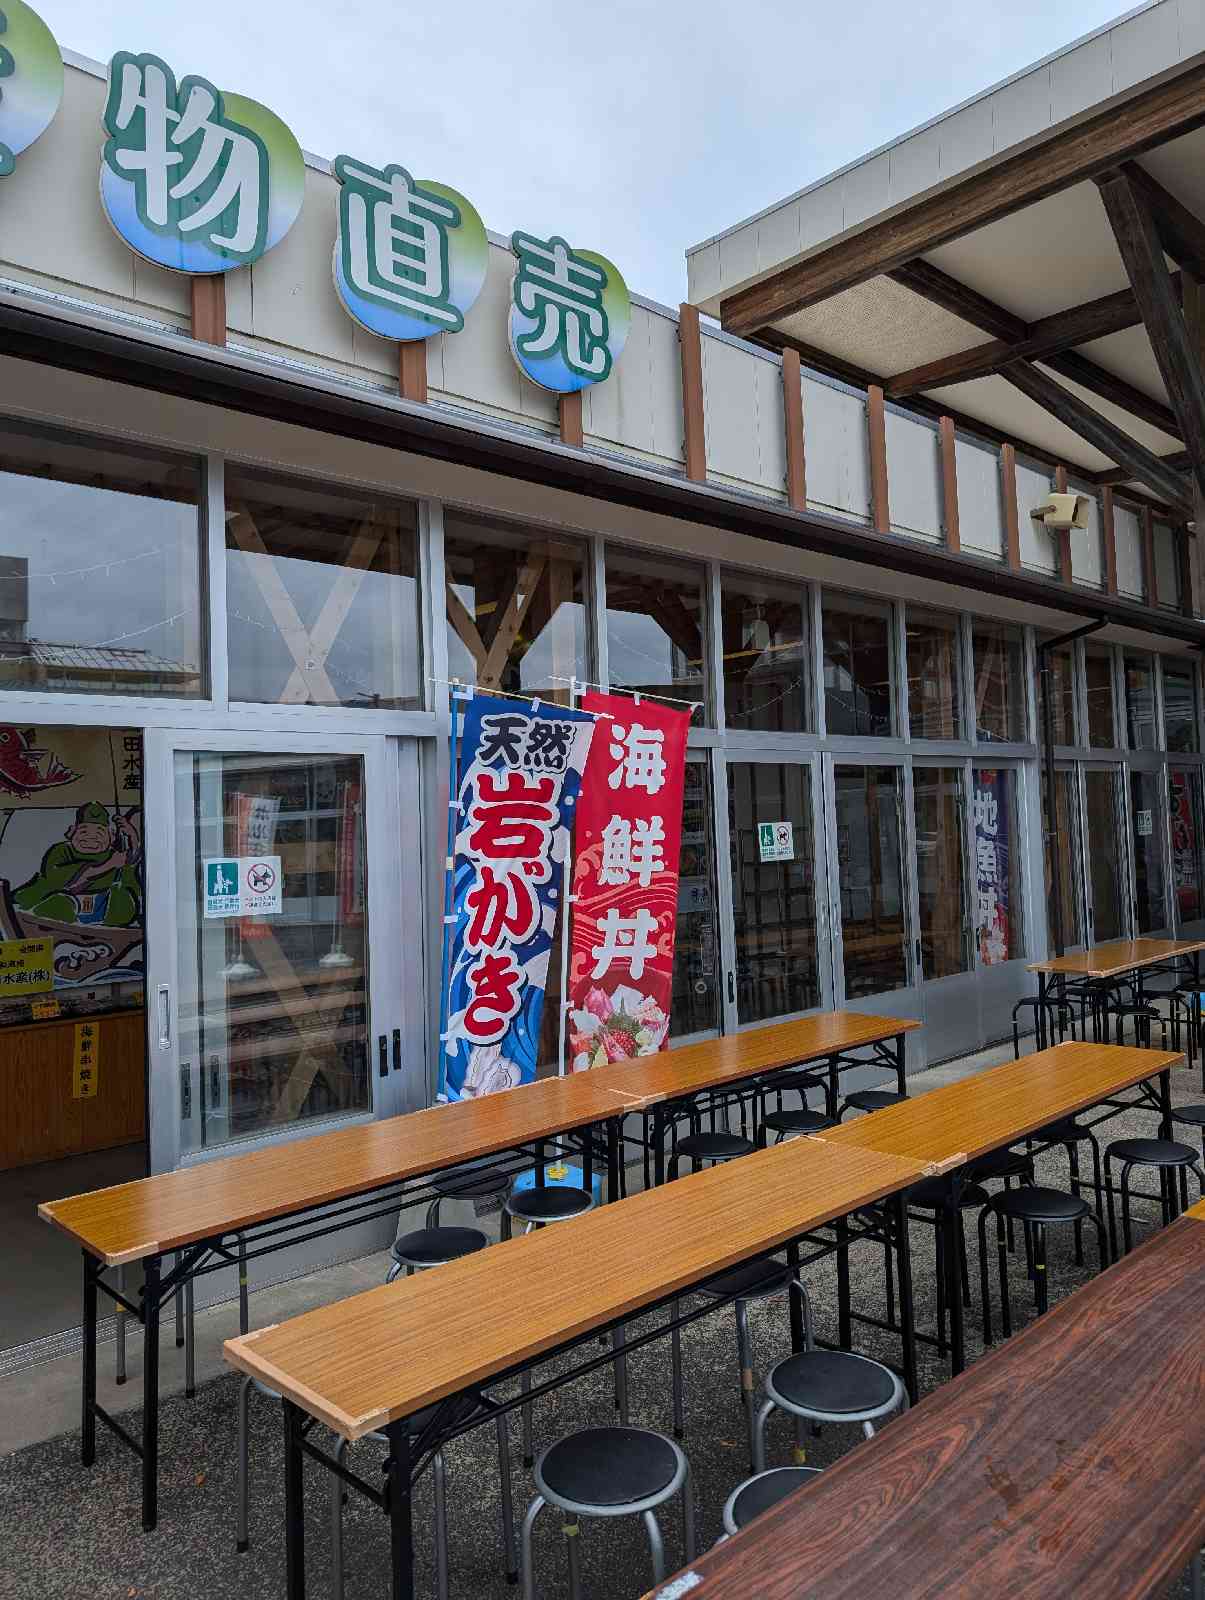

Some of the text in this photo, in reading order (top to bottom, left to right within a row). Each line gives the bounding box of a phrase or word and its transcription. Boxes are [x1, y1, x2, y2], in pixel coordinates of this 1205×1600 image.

[0, 14, 612, 380] 物直売
[478, 716, 570, 771] 天然
[590, 722, 668, 980] 海鮮丼
[0, 969, 50, 985] 水産(株)
[464, 772, 554, 1037] 岩がき
